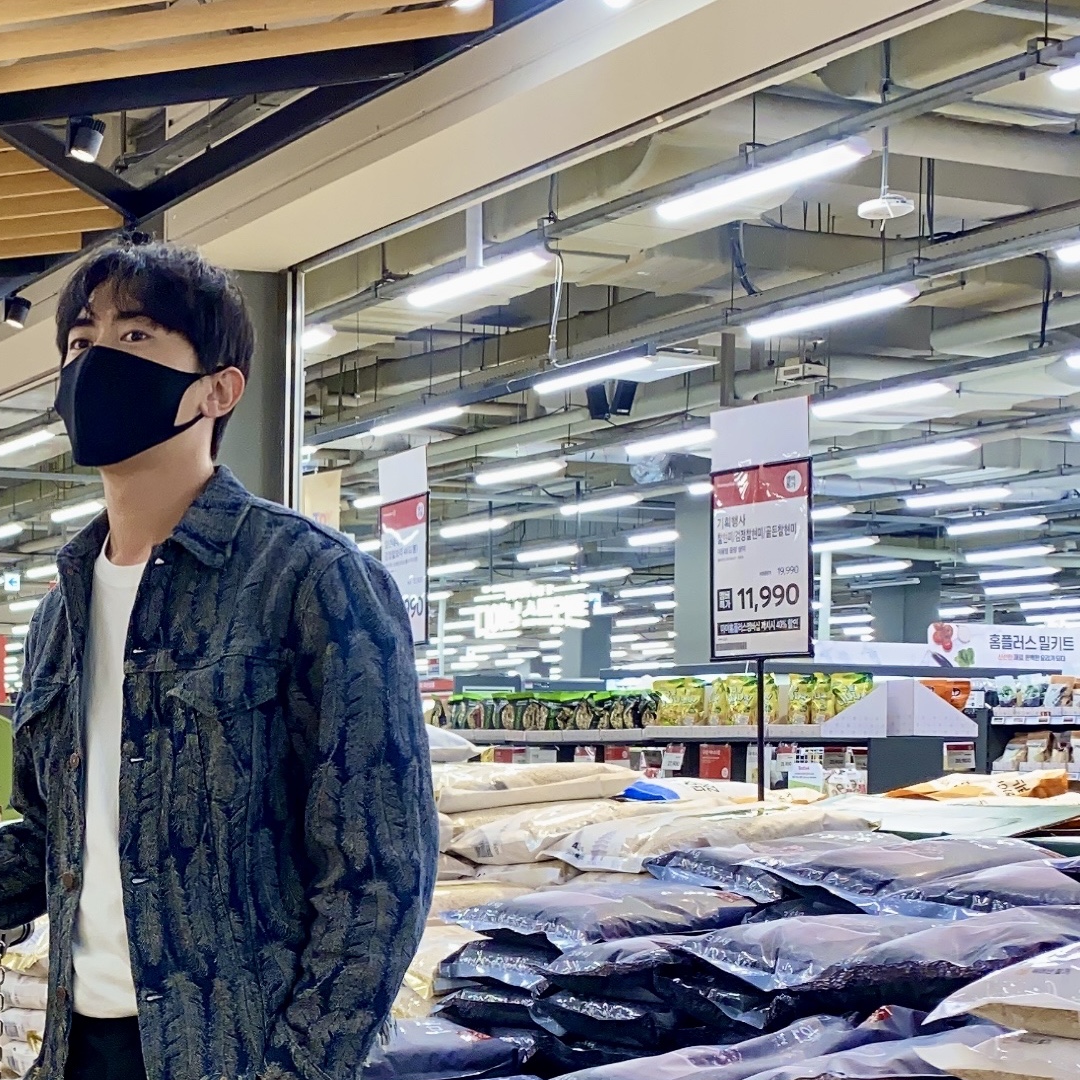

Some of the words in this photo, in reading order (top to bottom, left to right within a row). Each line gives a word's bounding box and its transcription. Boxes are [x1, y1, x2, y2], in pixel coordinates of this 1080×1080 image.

[777, 565, 799, 575] 19,990
[737, 583, 800, 612] 11,990
[989, 633, 1037, 650] 홈플러스
[1039, 635, 1075, 651] 밀키트
